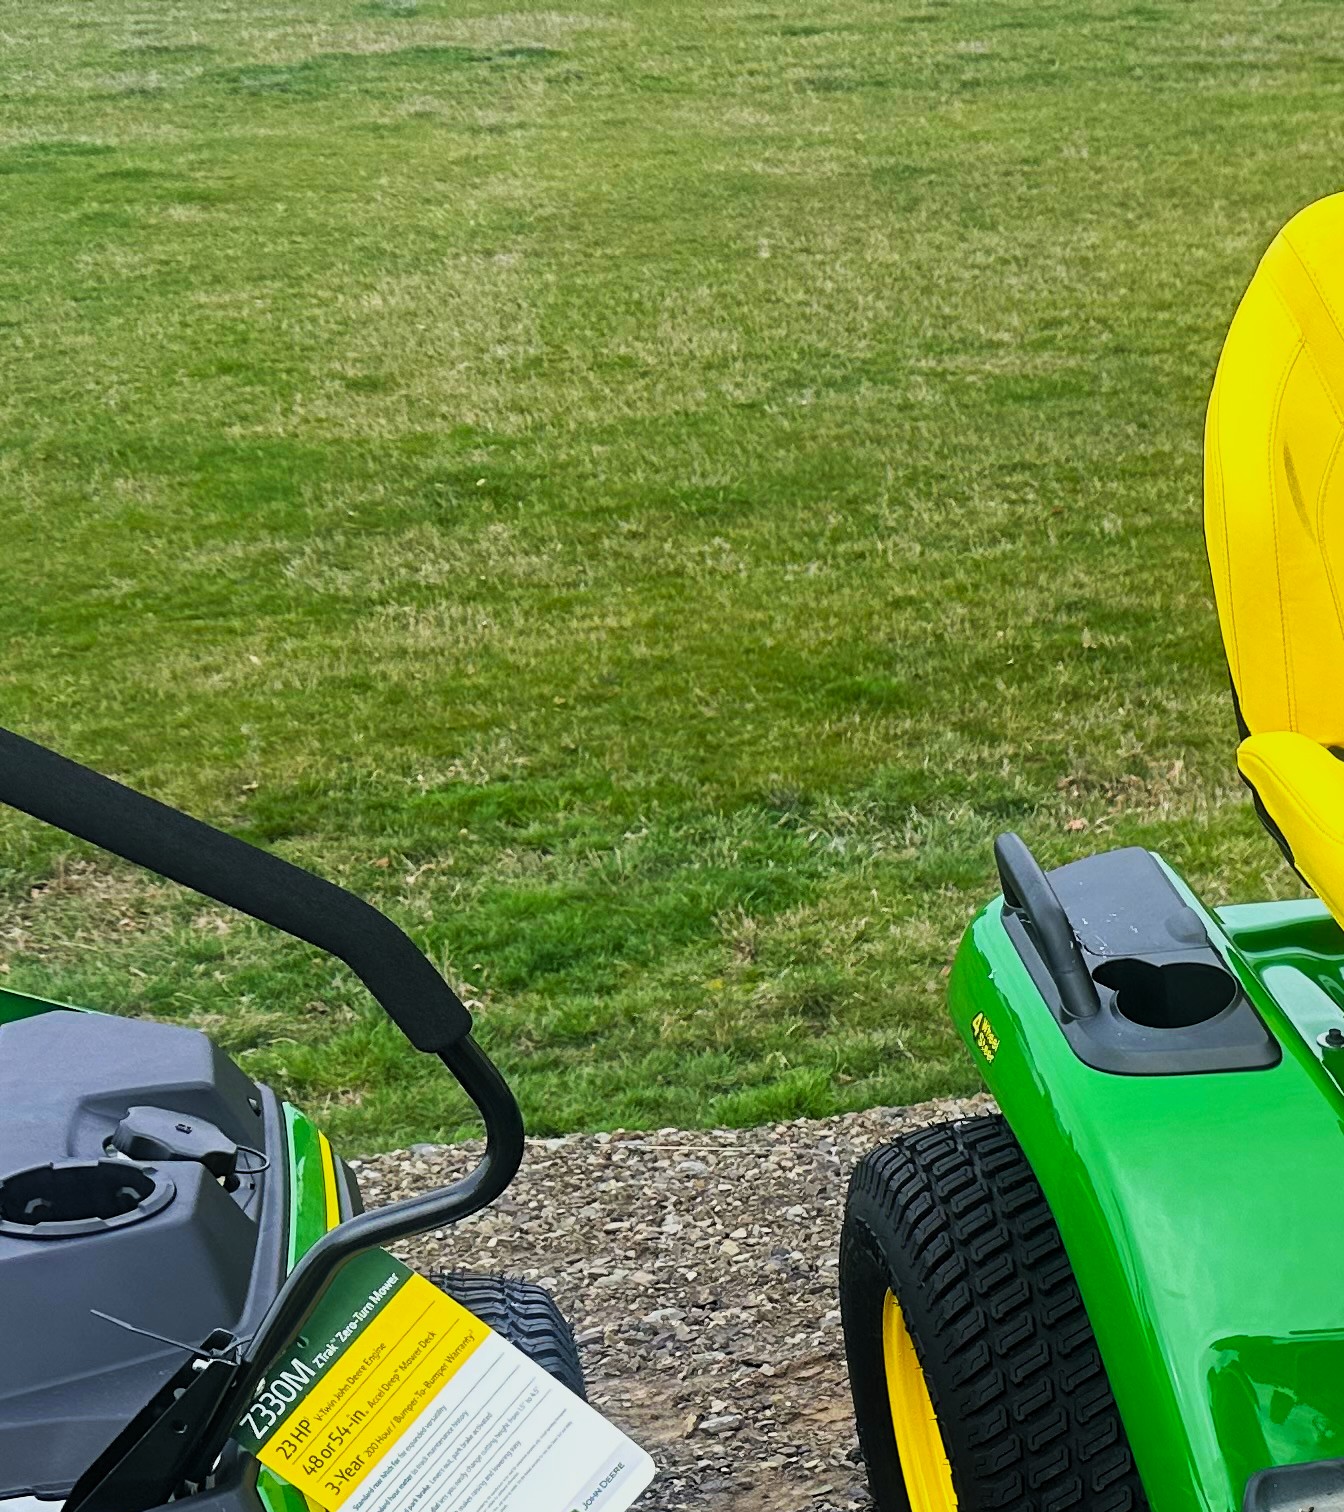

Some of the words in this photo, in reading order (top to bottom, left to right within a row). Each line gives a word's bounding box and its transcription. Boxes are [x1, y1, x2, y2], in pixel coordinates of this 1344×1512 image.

[972, 1012, 984, 1037] 4
[240, 1359, 315, 1439] Z330M
[335, 1302, 375, 1342] Zero-Turn
[368, 1272, 399, 1304] Mower
[275, 1439, 298, 1460] 23
[313, 1399, 337, 1422] V-Twin
[333, 1383, 352, 1401] John
[345, 1365, 367, 1385] Deere
[362, 1343, 387, 1367] Engine
[302, 1455, 325, 1476] 48
[320, 1442, 336, 1459] or
[328, 1410, 369, 1446] 54-in.
[366, 1388, 386, 1409] Accel
[398, 1347, 422, 1372] Mower
[417, 1331, 437, 1349] Deck
[324, 1455, 365, 1496] 3-Year
[363, 1442, 379, 1458] 200
[374, 1426, 393, 1445] Hour
[582, 1487, 603, 1511] JOHN
[599, 1462, 625, 1489] DEERE
